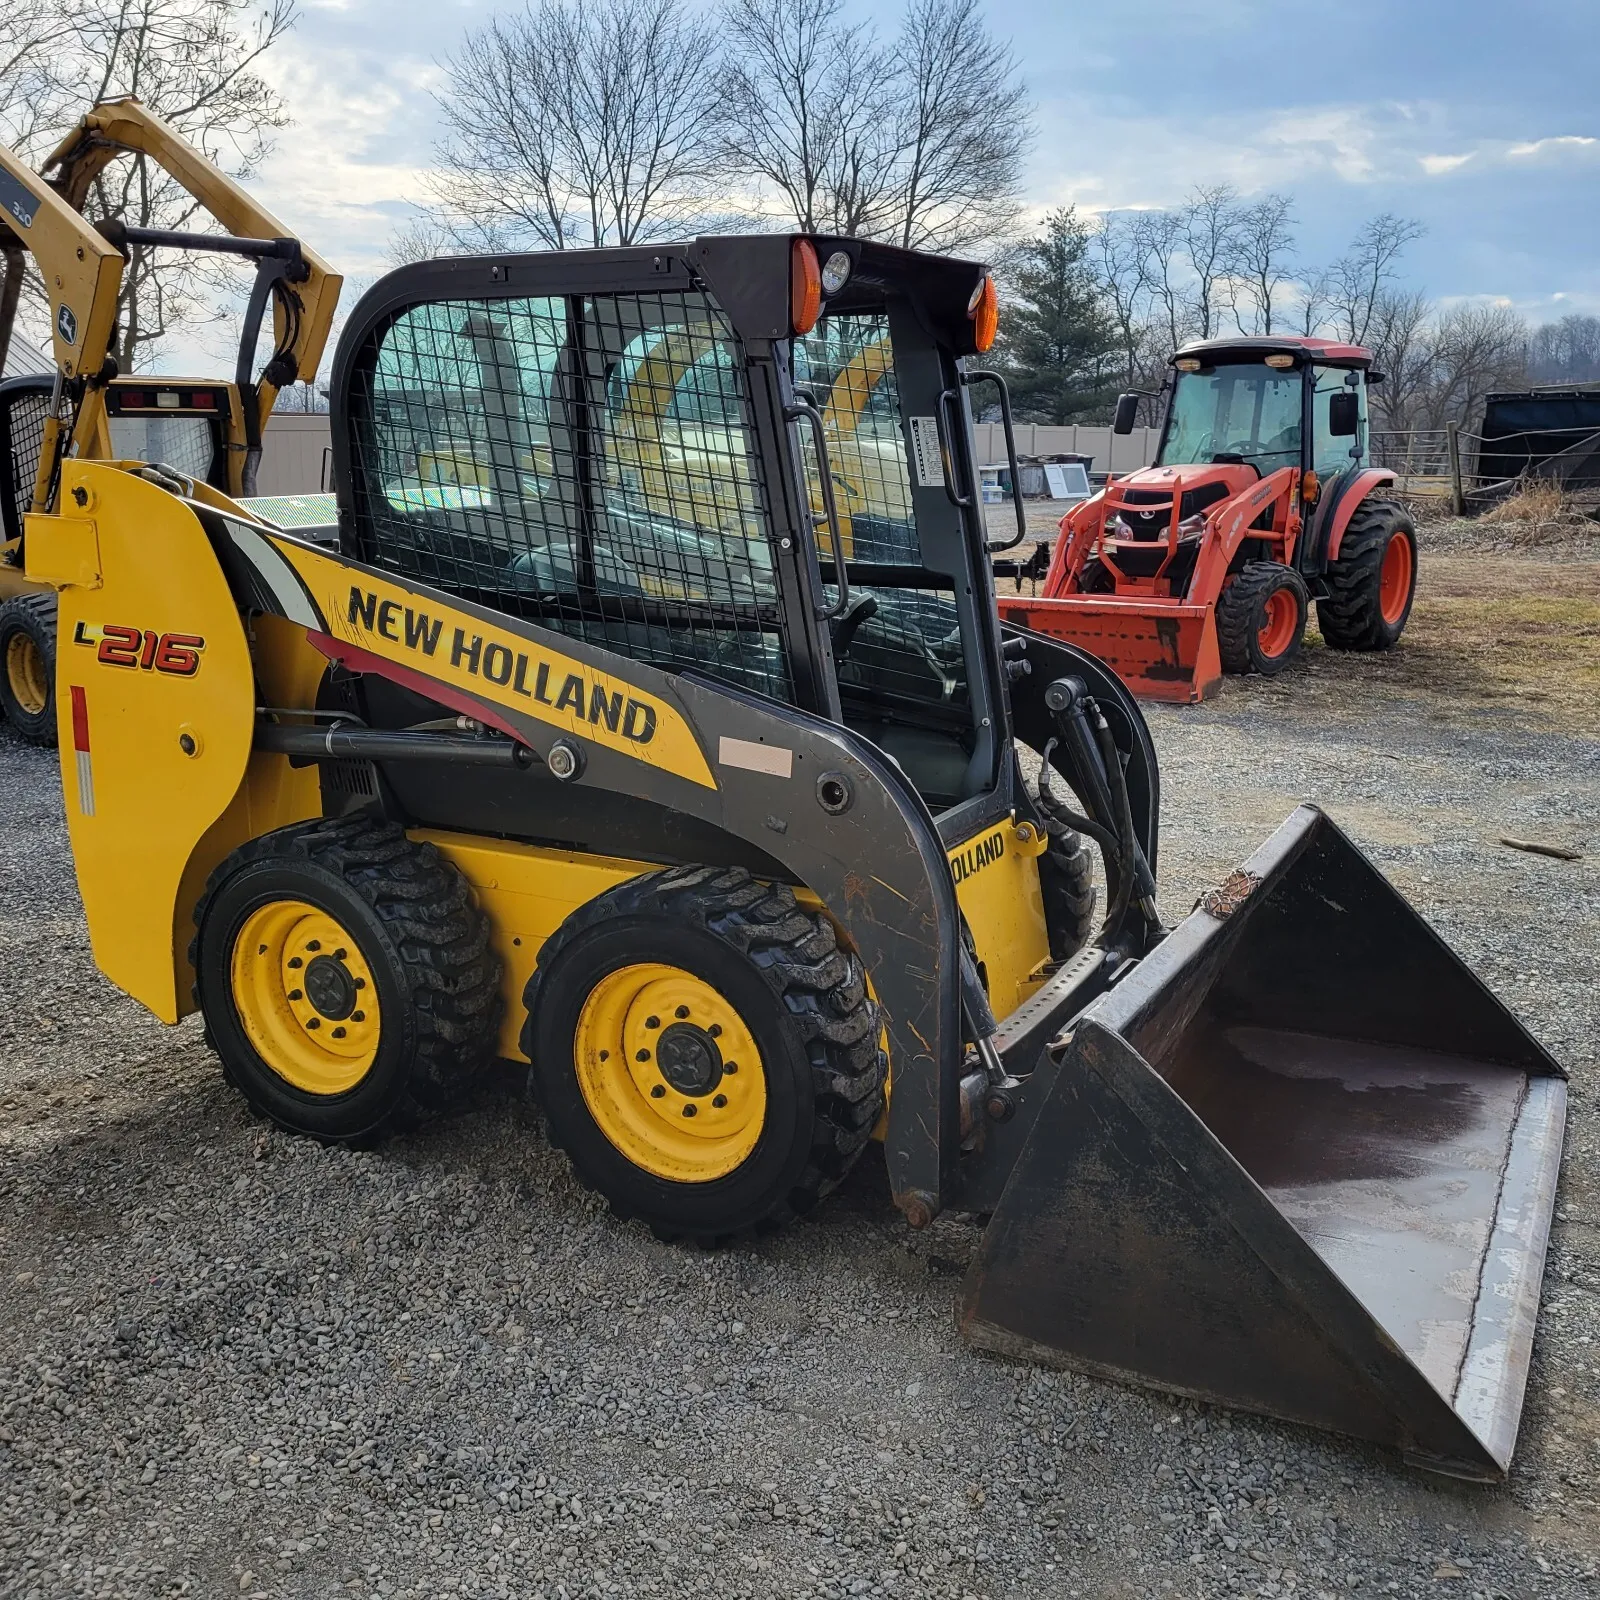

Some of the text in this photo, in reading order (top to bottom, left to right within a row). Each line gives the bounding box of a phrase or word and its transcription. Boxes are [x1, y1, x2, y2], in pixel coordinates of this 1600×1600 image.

[347, 586, 657, 745] NEW HOLLAND
[950, 831, 1005, 885] OLLAND
